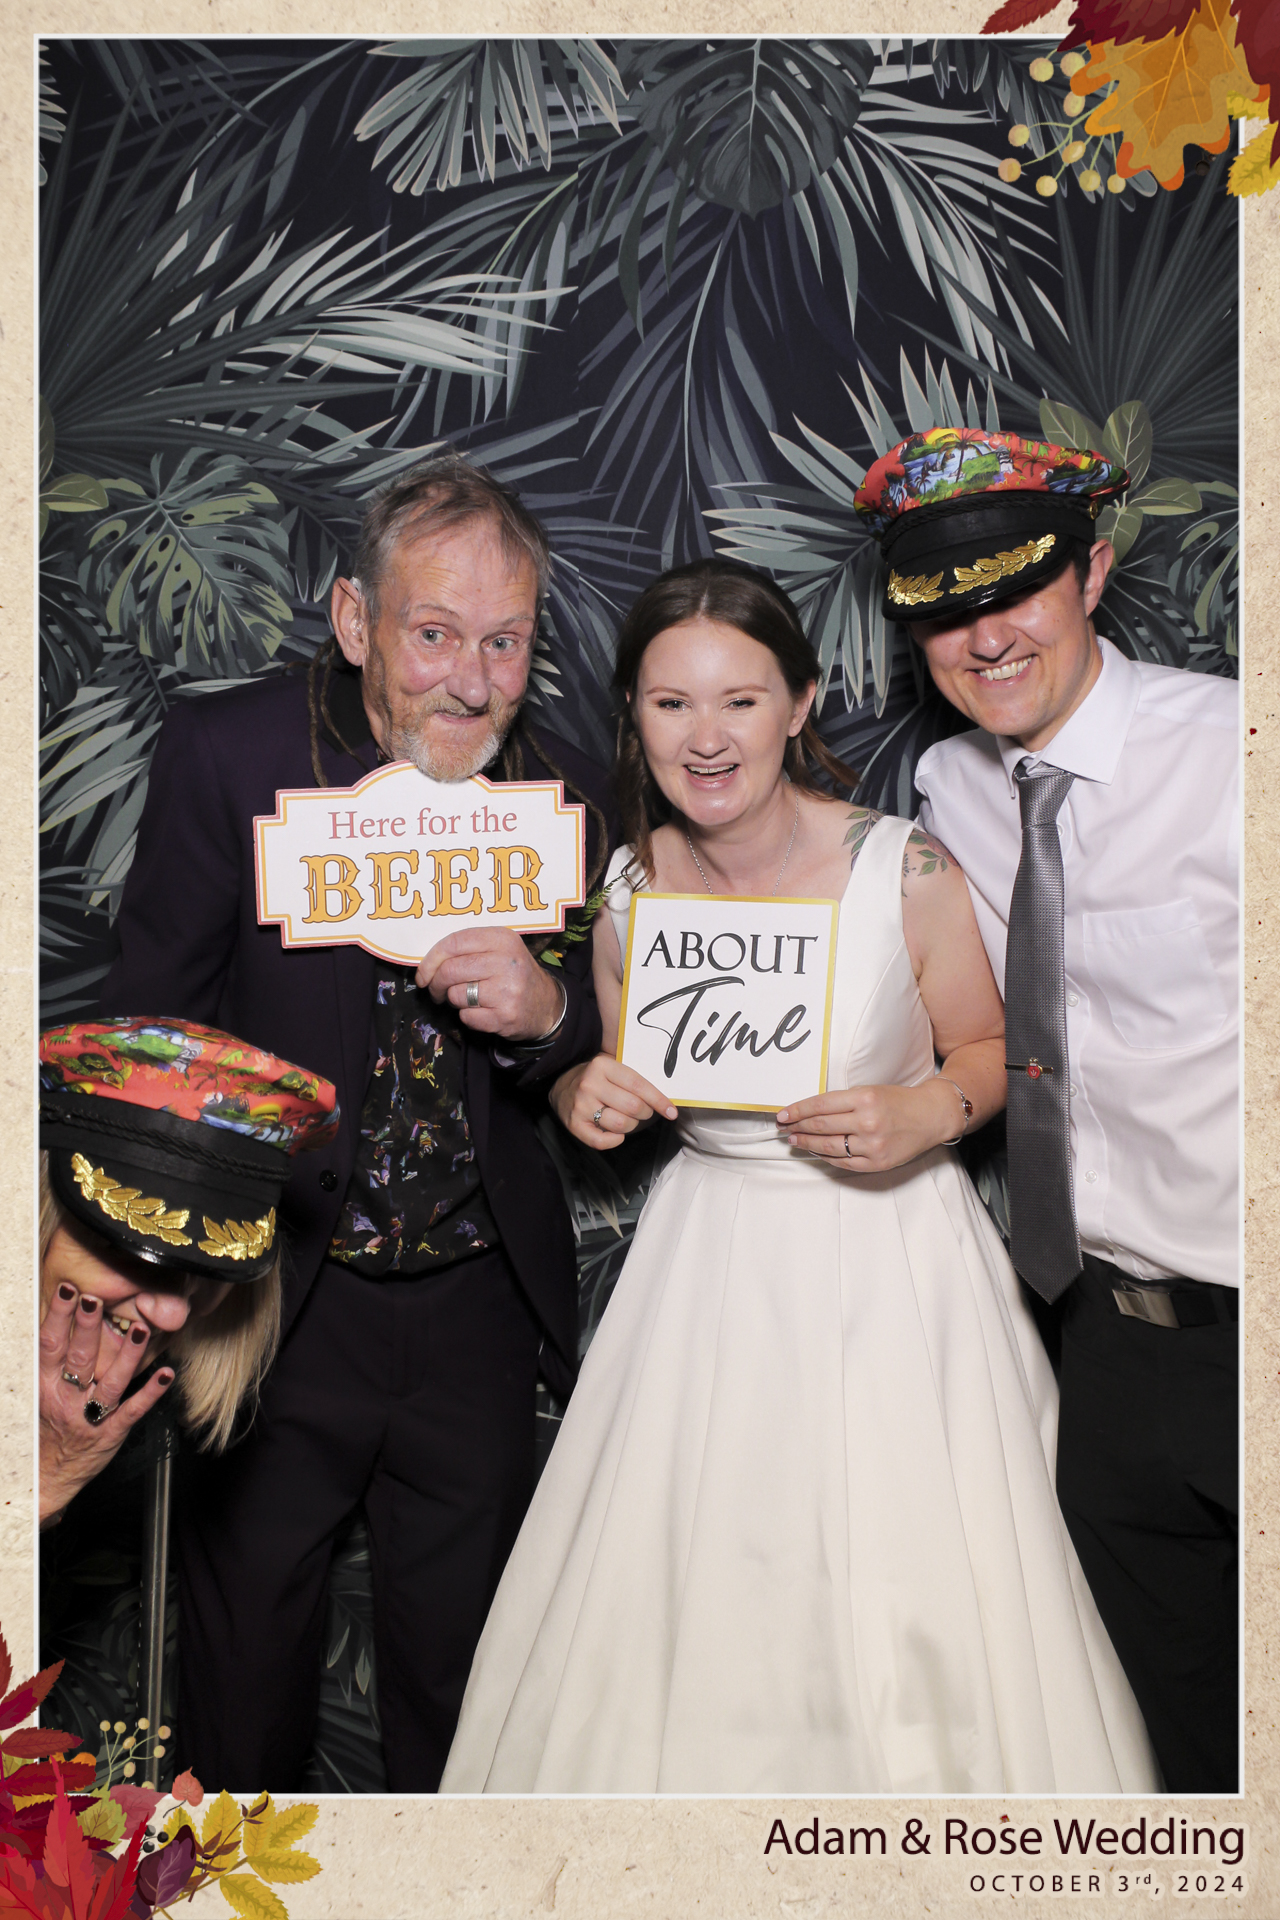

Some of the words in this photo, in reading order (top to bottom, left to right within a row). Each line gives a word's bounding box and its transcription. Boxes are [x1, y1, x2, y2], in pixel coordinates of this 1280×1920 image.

[328, 810, 406, 839] Here
[416, 807, 462, 836] for
[470, 805, 518, 834] the
[299, 845, 549, 924] BEER
[641, 929, 819, 975] ABOUT
[636, 975, 812, 1078] Time
